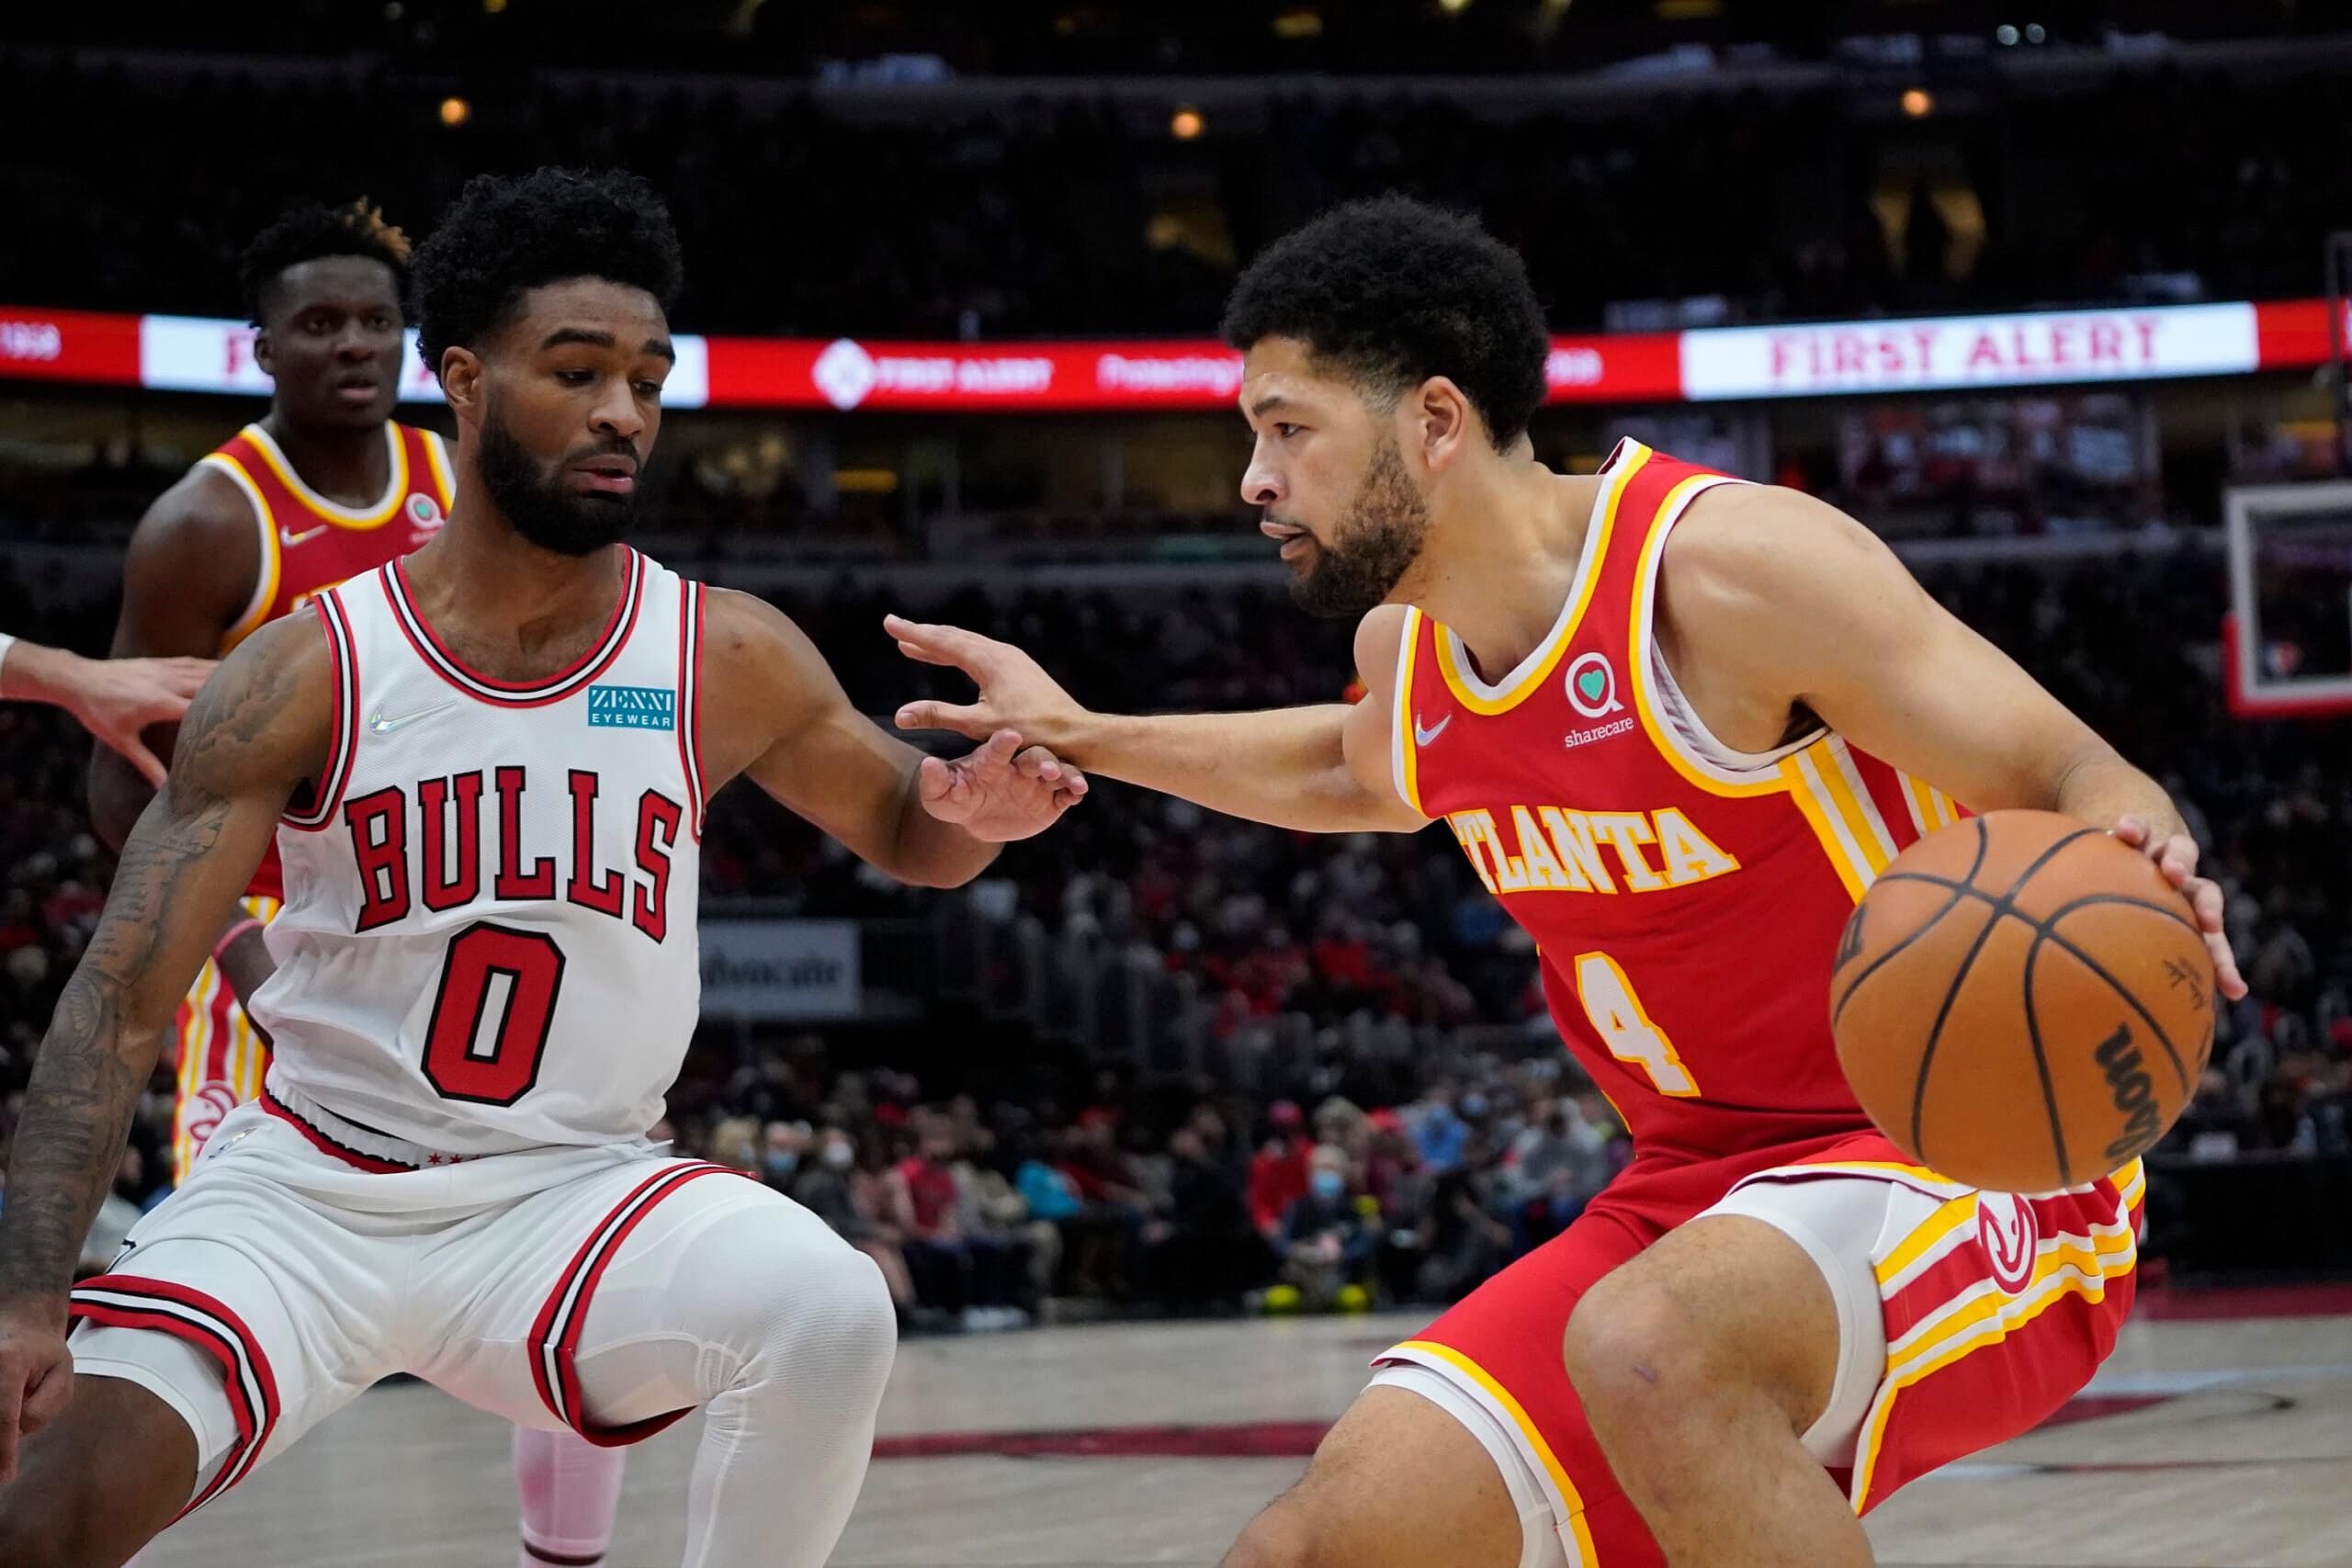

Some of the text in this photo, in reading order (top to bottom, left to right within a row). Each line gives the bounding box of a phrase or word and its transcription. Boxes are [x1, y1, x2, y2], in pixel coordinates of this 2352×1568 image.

[1769, 314, 2164, 379] FIRST ALERT
[592, 690, 672, 711] ZENNI
[592, 713, 671, 727] EYEWEAR
[1565, 716, 1634, 748] sharecare
[344, 765, 683, 944] BULLS
[1449, 805, 1742, 895] TLANTA
[421, 920, 566, 1108] 0
[1575, 950, 1702, 1097] 4
[2094, 1021, 2162, 1161] lson
